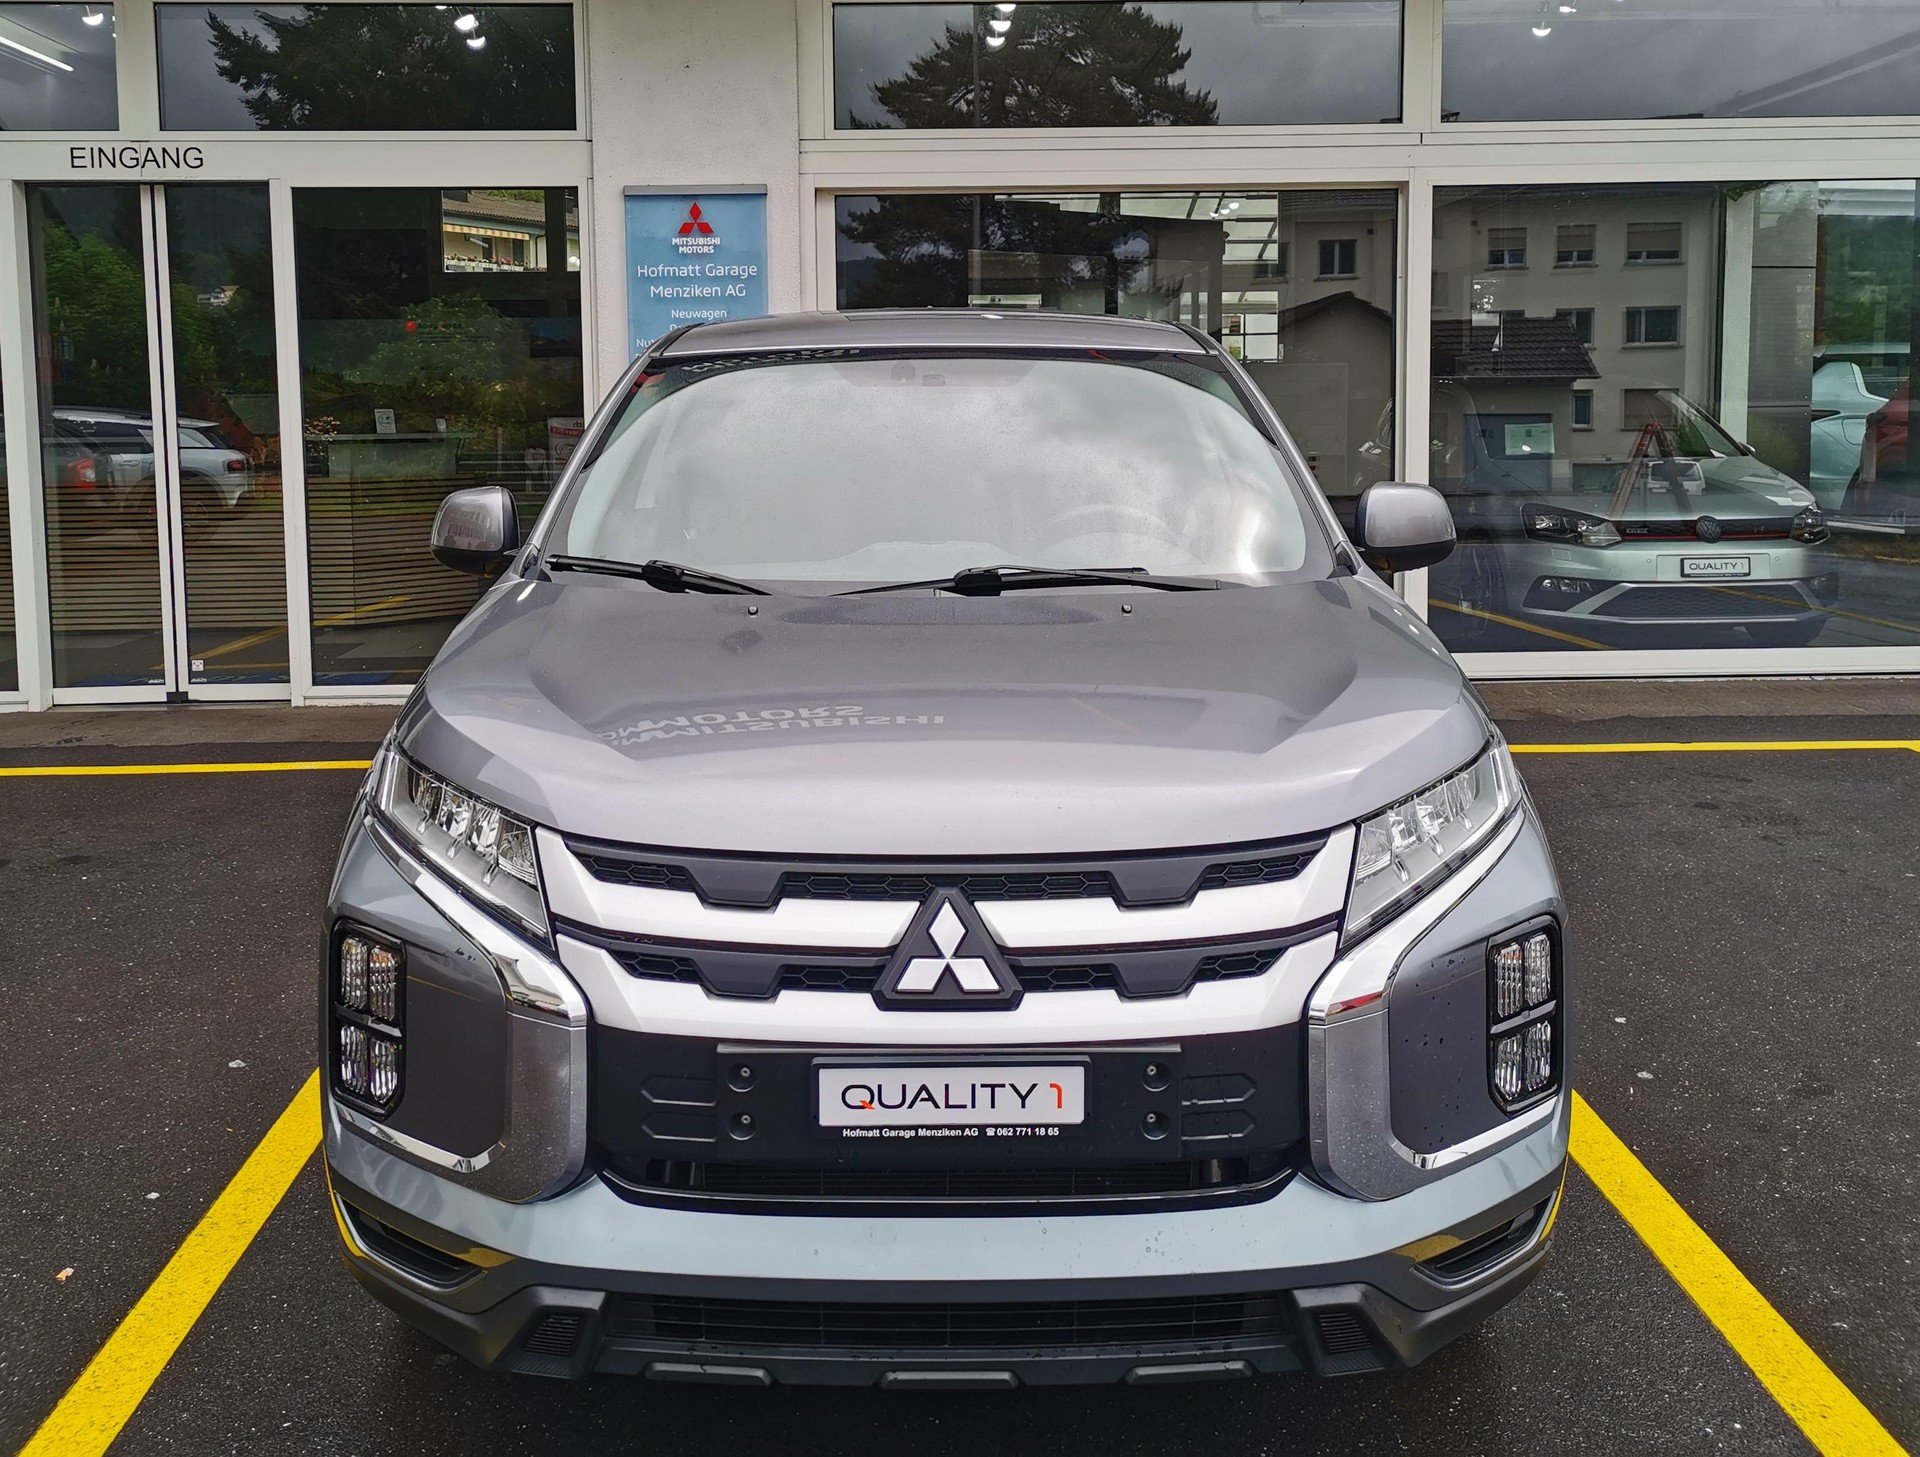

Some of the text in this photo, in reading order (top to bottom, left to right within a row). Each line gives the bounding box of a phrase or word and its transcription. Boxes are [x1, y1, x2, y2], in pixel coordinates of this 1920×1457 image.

[69, 146, 204, 169] EINGANG
[672, 237, 721, 246] MITSUBISHI
[678, 246, 715, 254] MOTORS
[637, 263, 758, 279] Hofmatt Garage
[650, 284, 747, 298] Menziken AG
[671, 308, 728, 320] Neuwagen
[1689, 562, 1738, 571] QUALITY
[840, 1083, 1063, 1110] QUALITY 1
[842, 1127, 1060, 1139] Hofmatt Garage Menziken AG 062 771 18 65
